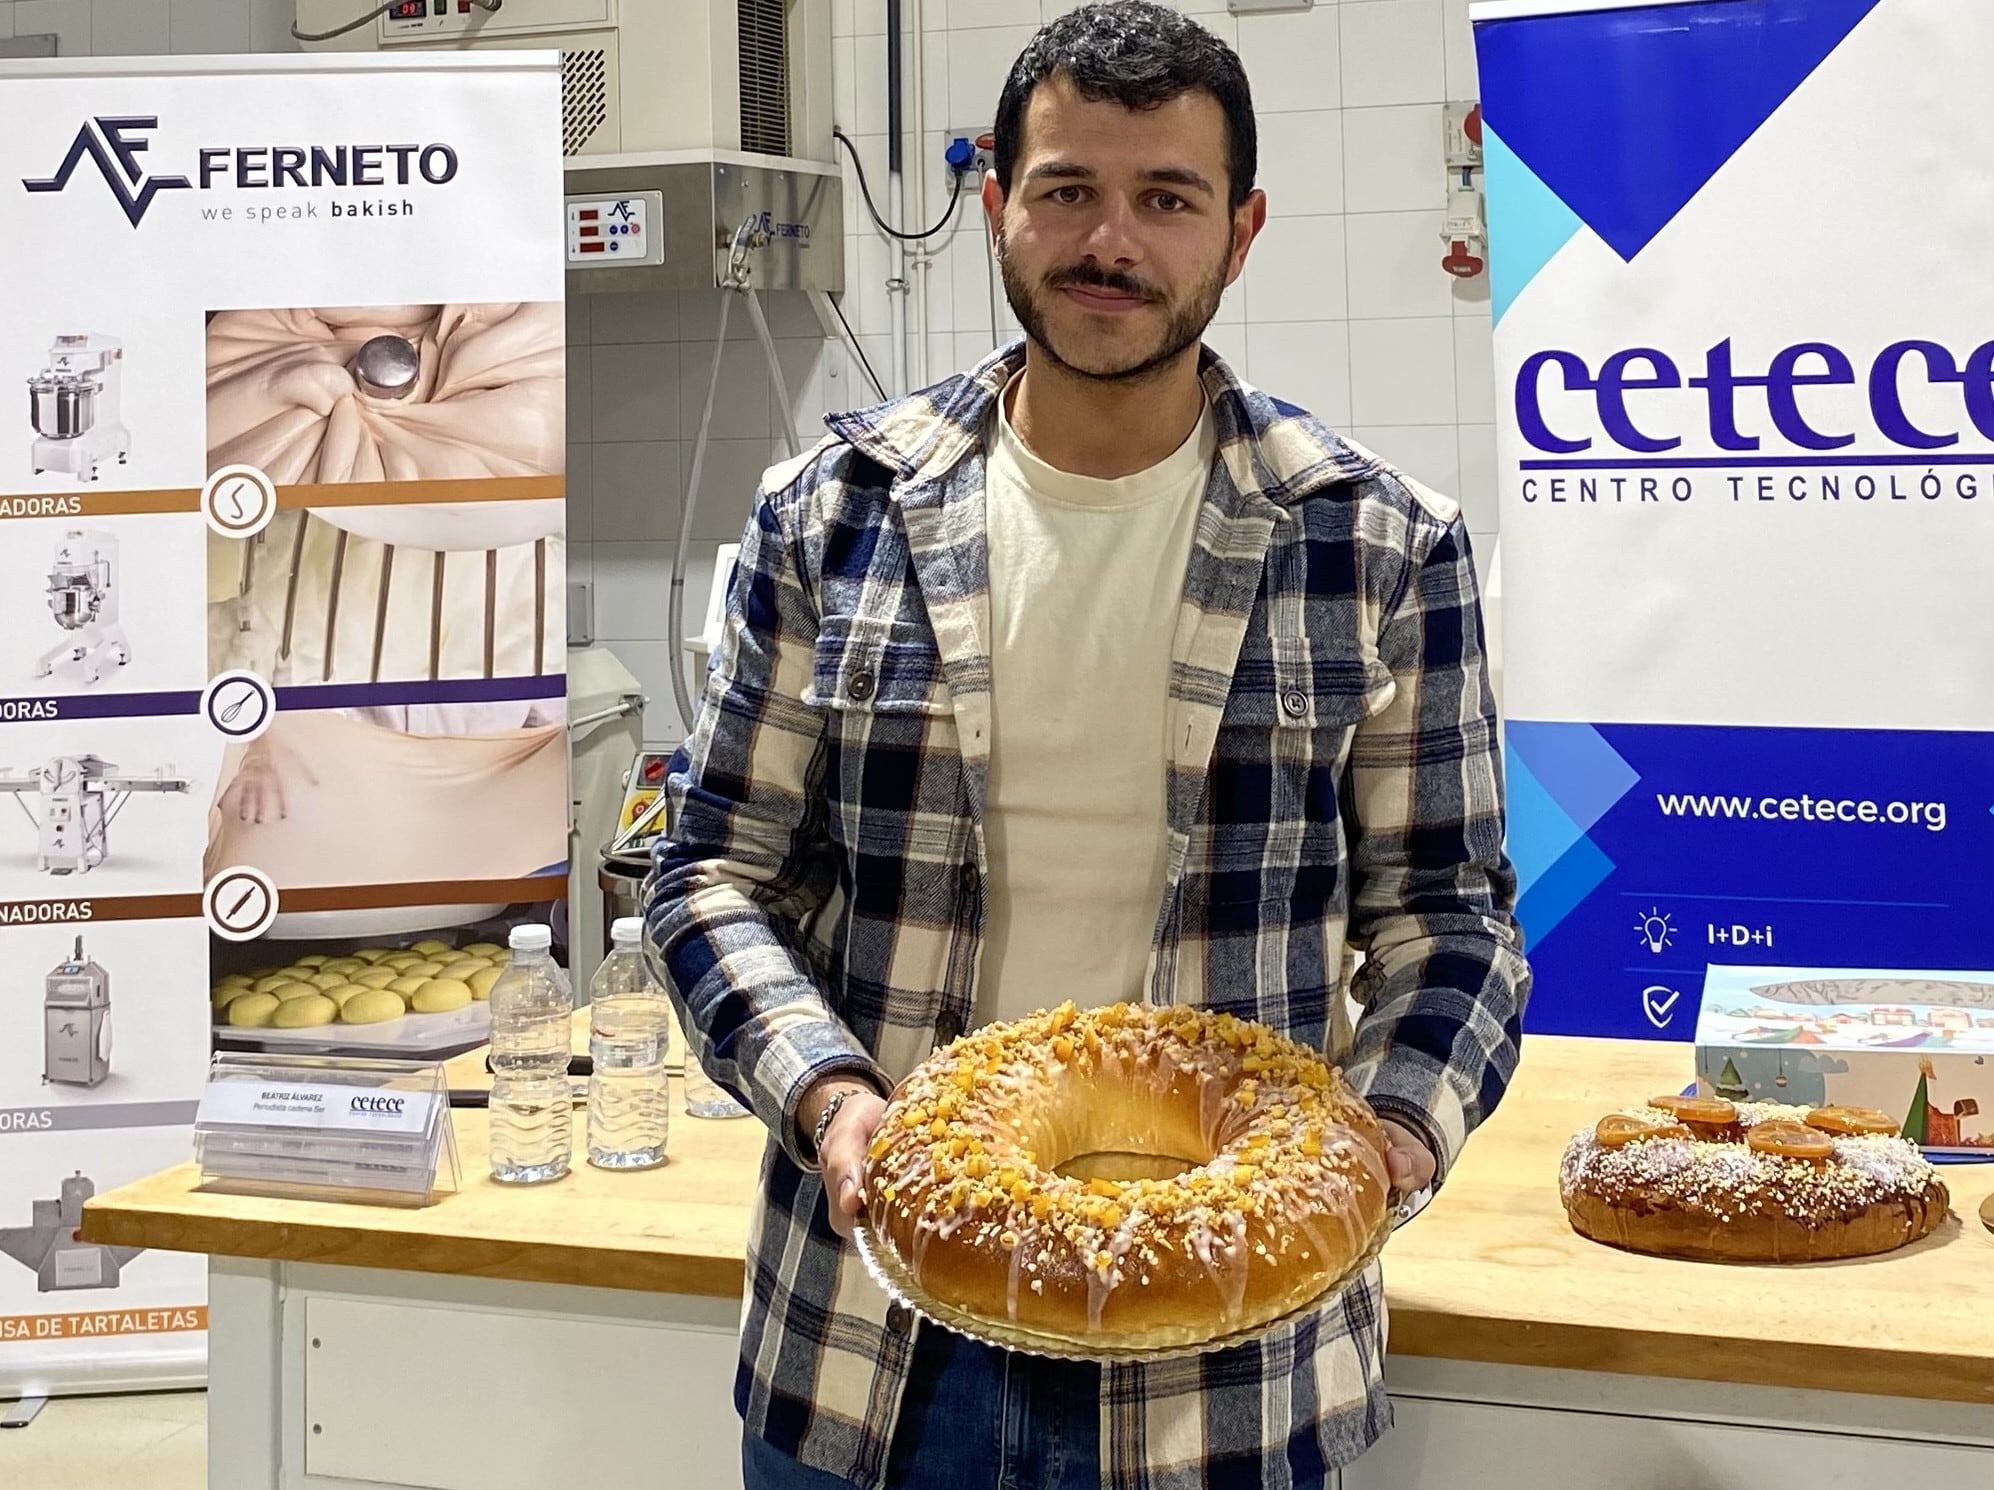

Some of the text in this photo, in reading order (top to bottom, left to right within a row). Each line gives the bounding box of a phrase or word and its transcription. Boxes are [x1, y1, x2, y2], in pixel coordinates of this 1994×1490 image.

[199, 142, 459, 190] FERNETO
[201, 199, 414, 224] we speak bakish
[1522, 468, 1994, 503] CENTRO TECNOLÓG
[0, 496, 82, 516] ADORAS
[0, 700, 58, 719] ORAS
[1656, 793, 1947, 832] www.cetece.org
[1707, 923, 1774, 947] I+D+i
[262, 1091, 323, 1102] BEATRIZ ÁLVAREZ
[0, 1310, 199, 1338] SA DE TARTALETAS
